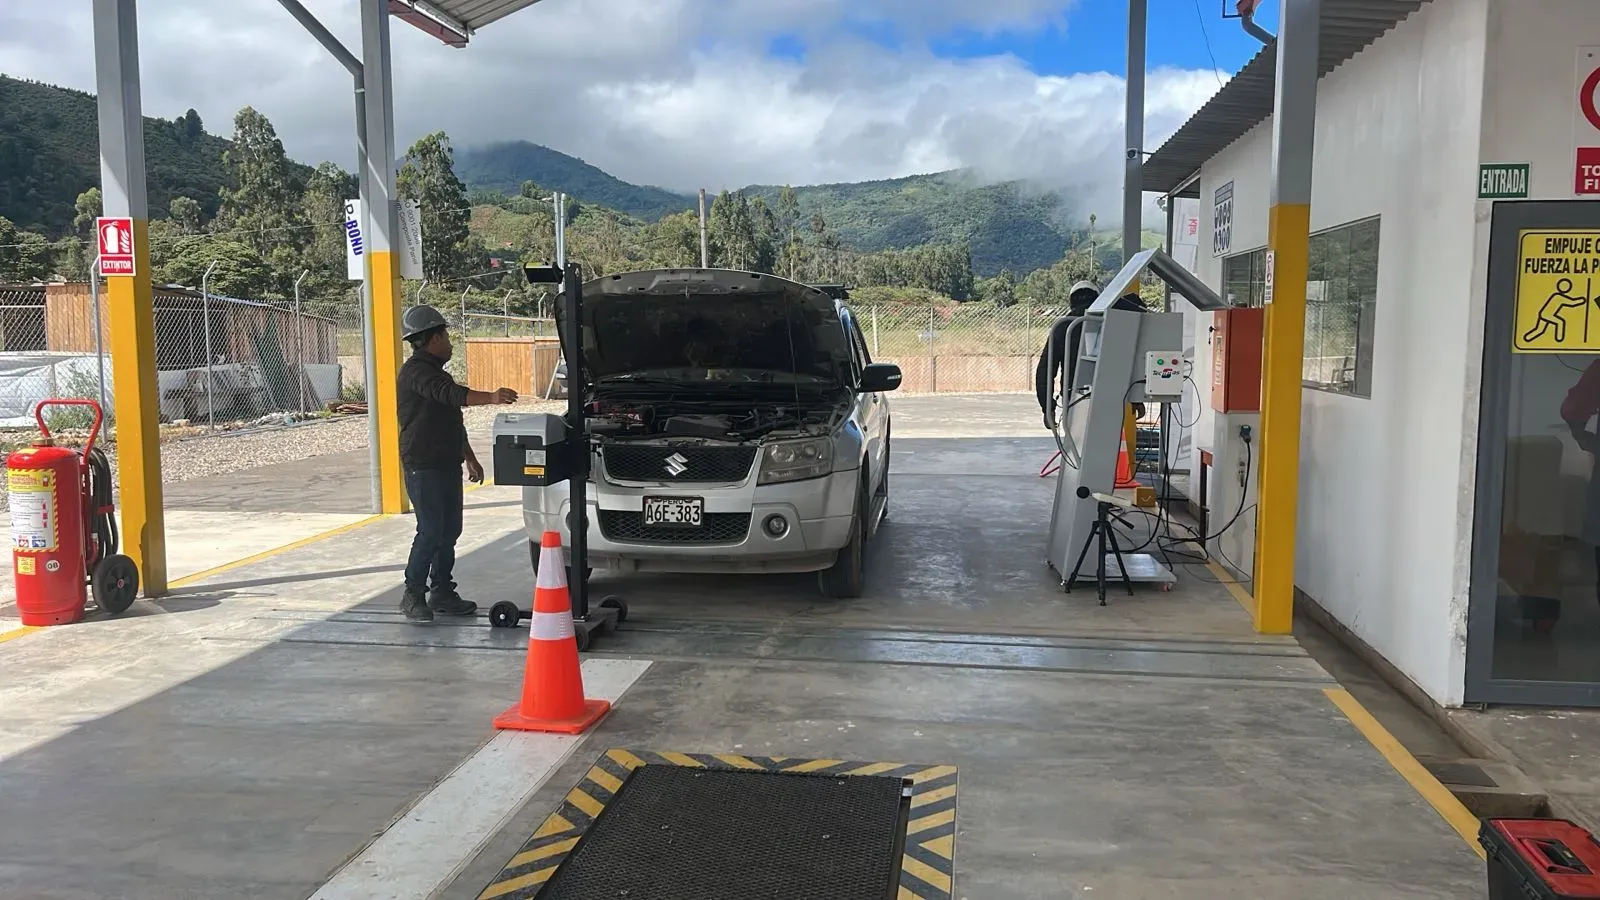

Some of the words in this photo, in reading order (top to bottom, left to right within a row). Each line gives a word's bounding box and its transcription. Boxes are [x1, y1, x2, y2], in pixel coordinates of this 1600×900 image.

[1481, 168, 1526, 194] ENTRADA
[1545, 238, 1592, 254] EMPUJE
[103, 260, 132, 270] EXTINTOR
[1525, 258, 1570, 274] FUERZA
[1574, 258, 1588, 274] LA
[646, 504, 700, 522] A6E-383
